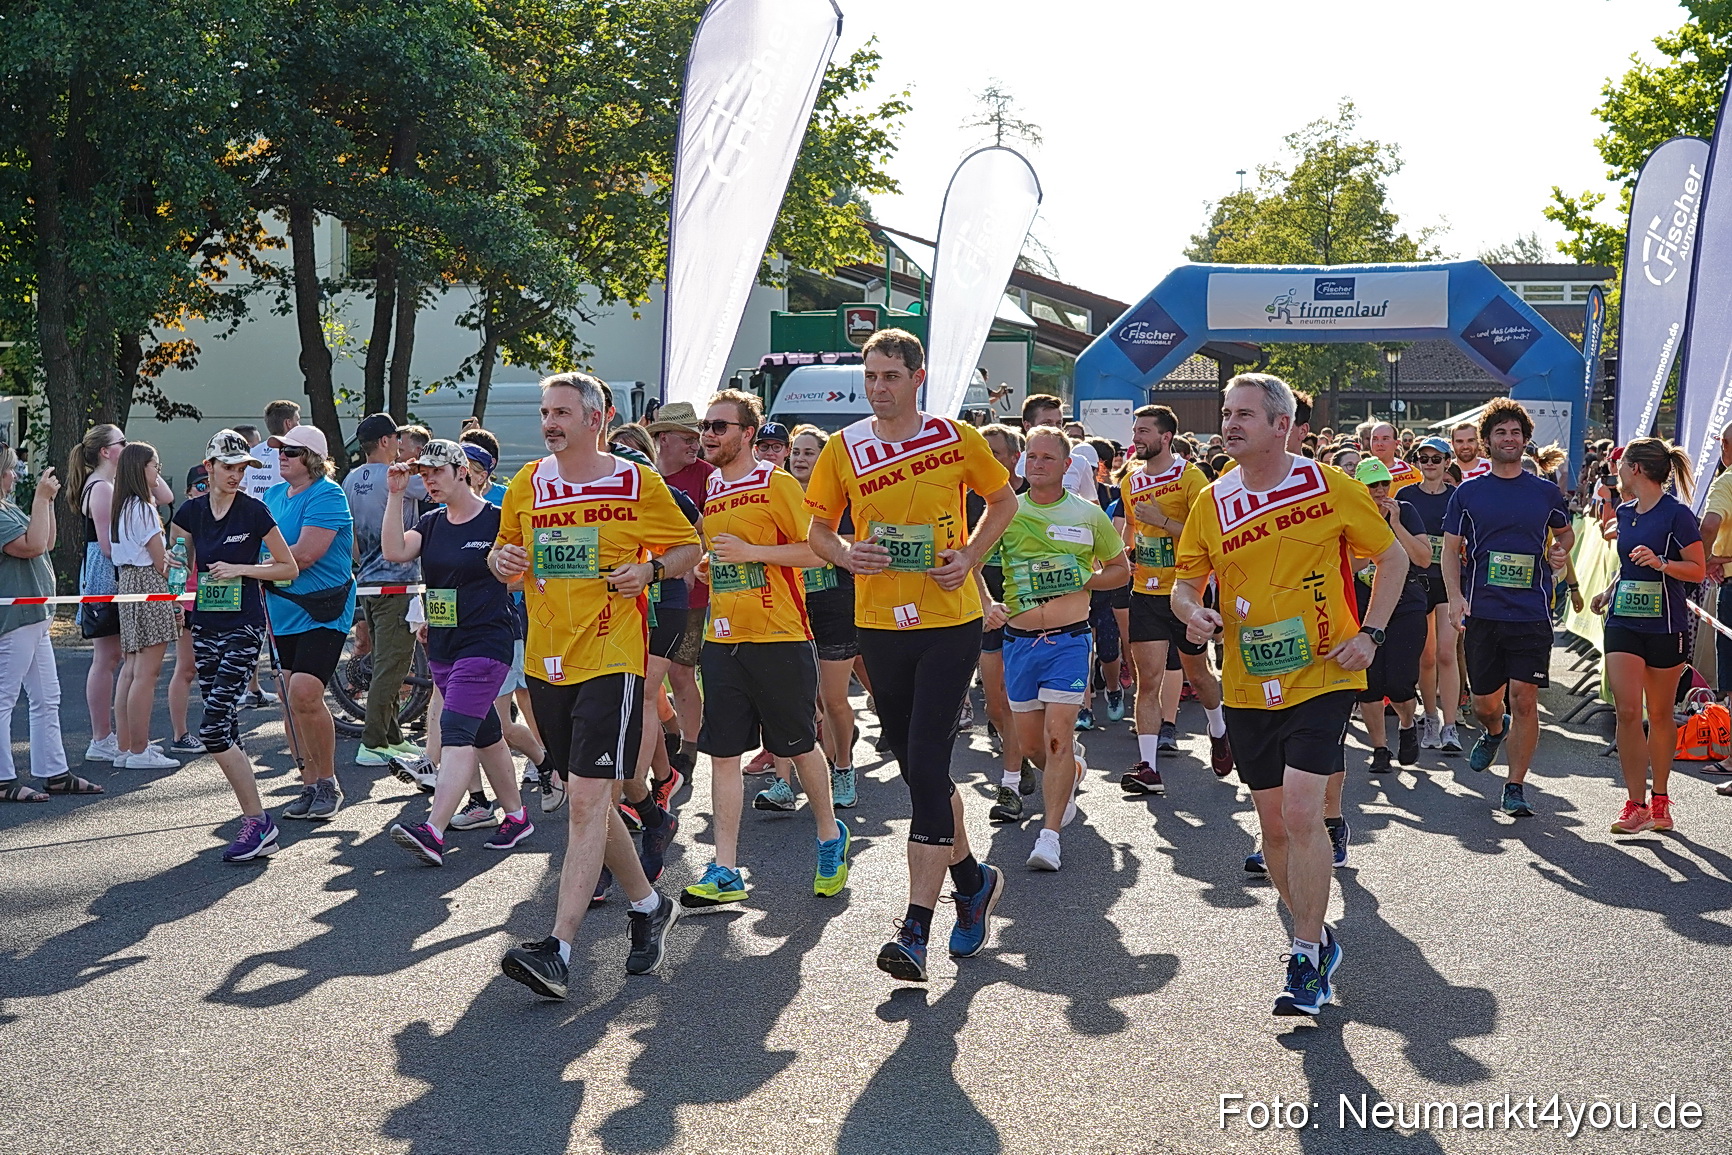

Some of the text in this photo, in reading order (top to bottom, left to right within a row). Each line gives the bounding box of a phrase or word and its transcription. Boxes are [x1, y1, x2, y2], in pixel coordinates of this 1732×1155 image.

[1656, 163, 1702, 266] Fischer
[1322, 285, 1353, 293] Fischer
[1300, 300, 1389, 317] firmenlauf
[1128, 329, 1177, 340] Fischer
[1490, 328, 1504, 336] das
[784, 392, 825, 401] abavent
[859, 449, 965, 497] MAX BÖGL
[1130, 483, 1182, 506] MAX BÖGL
[703, 493, 770, 517] MAX BÖGL
[531, 503, 638, 529] MAX BÖGL
[1221, 501, 1334, 555] MAX BÖGL
[544, 545, 587, 562] 1624
[880, 539, 923, 557] 1587
[588, 547, 596, 571] 2022
[738, 563, 747, 584] 2022
[1037, 568, 1073, 585] 1475
[1500, 564, 1523, 577] 954
[206, 586, 228, 598] 867
[1625, 593, 1649, 605] 950
[429, 602, 446, 615] 865
[1250, 637, 1296, 661] 1627
[1298, 637, 1309, 660] 2022
[1244, 650, 1253, 667] RUN
[1274, 655, 1302, 665] Christian
